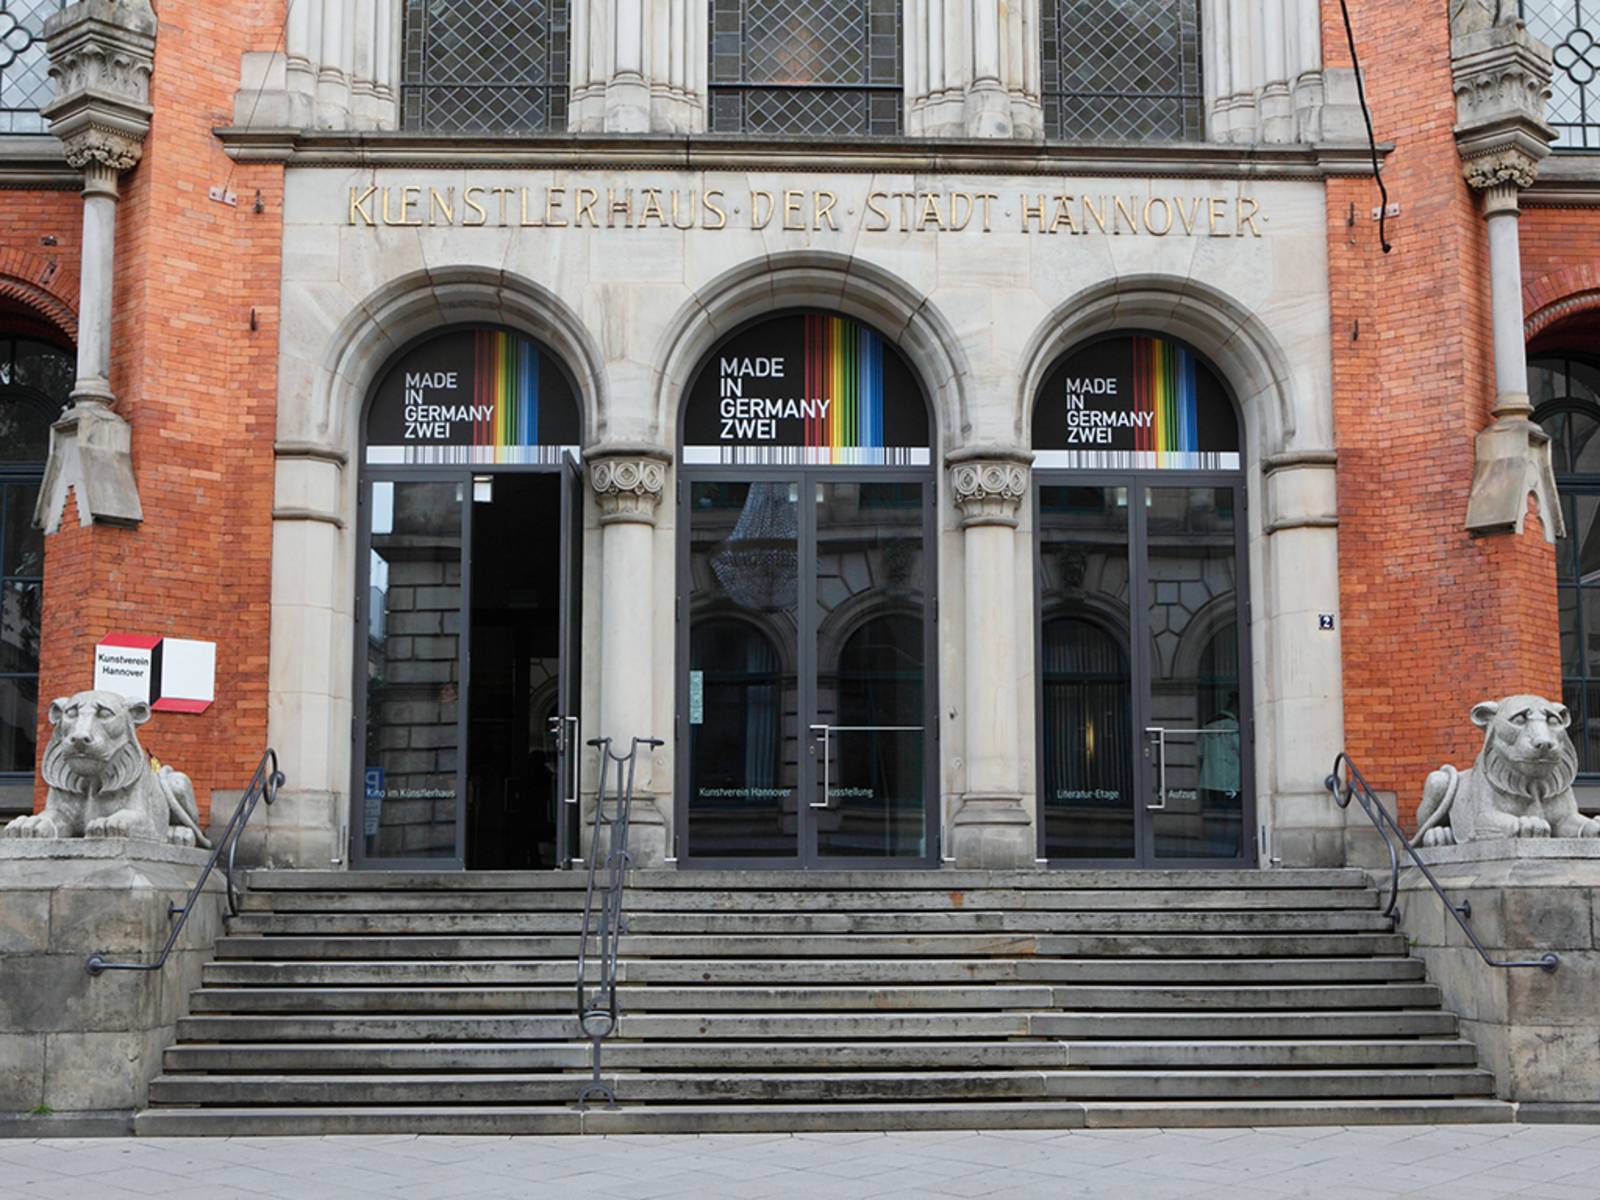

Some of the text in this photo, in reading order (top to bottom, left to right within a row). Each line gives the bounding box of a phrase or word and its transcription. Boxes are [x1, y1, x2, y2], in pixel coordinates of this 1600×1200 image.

[750, 189, 839, 232] DER
[865, 191, 998, 233] STADT
[1020, 193, 1262, 237] HANNOVER
[719, 357, 785, 377] MADE
[405, 372, 458, 388] MADE
[719, 378, 742, 397] IN
[1066, 378, 1118, 394] MADE
[404, 389, 423, 405] IN
[1066, 394, 1084, 410] IN
[404, 405, 494, 422] GERMANY
[719, 398, 830, 418] GERMANY
[1066, 411, 1154, 427] GERMANY
[404, 422, 450, 438] ZWEI
[719, 419, 776, 439] ZWEI
[1067, 427, 1112, 443] ZWEI
[1322, 615, 1331, 628] 2
[98, 653, 149, 666] Kunstverein
[102, 665, 144, 678] Hannover
[367, 788, 385, 798] Kino
[387, 788, 399, 798] im
[700, 787, 792, 798] Kunstverein Hannover
[827, 787, 874, 798] usstellung
[1056, 788, 1120, 799] Literatur-Etage
[1168, 789, 1198, 800] Aufzug
